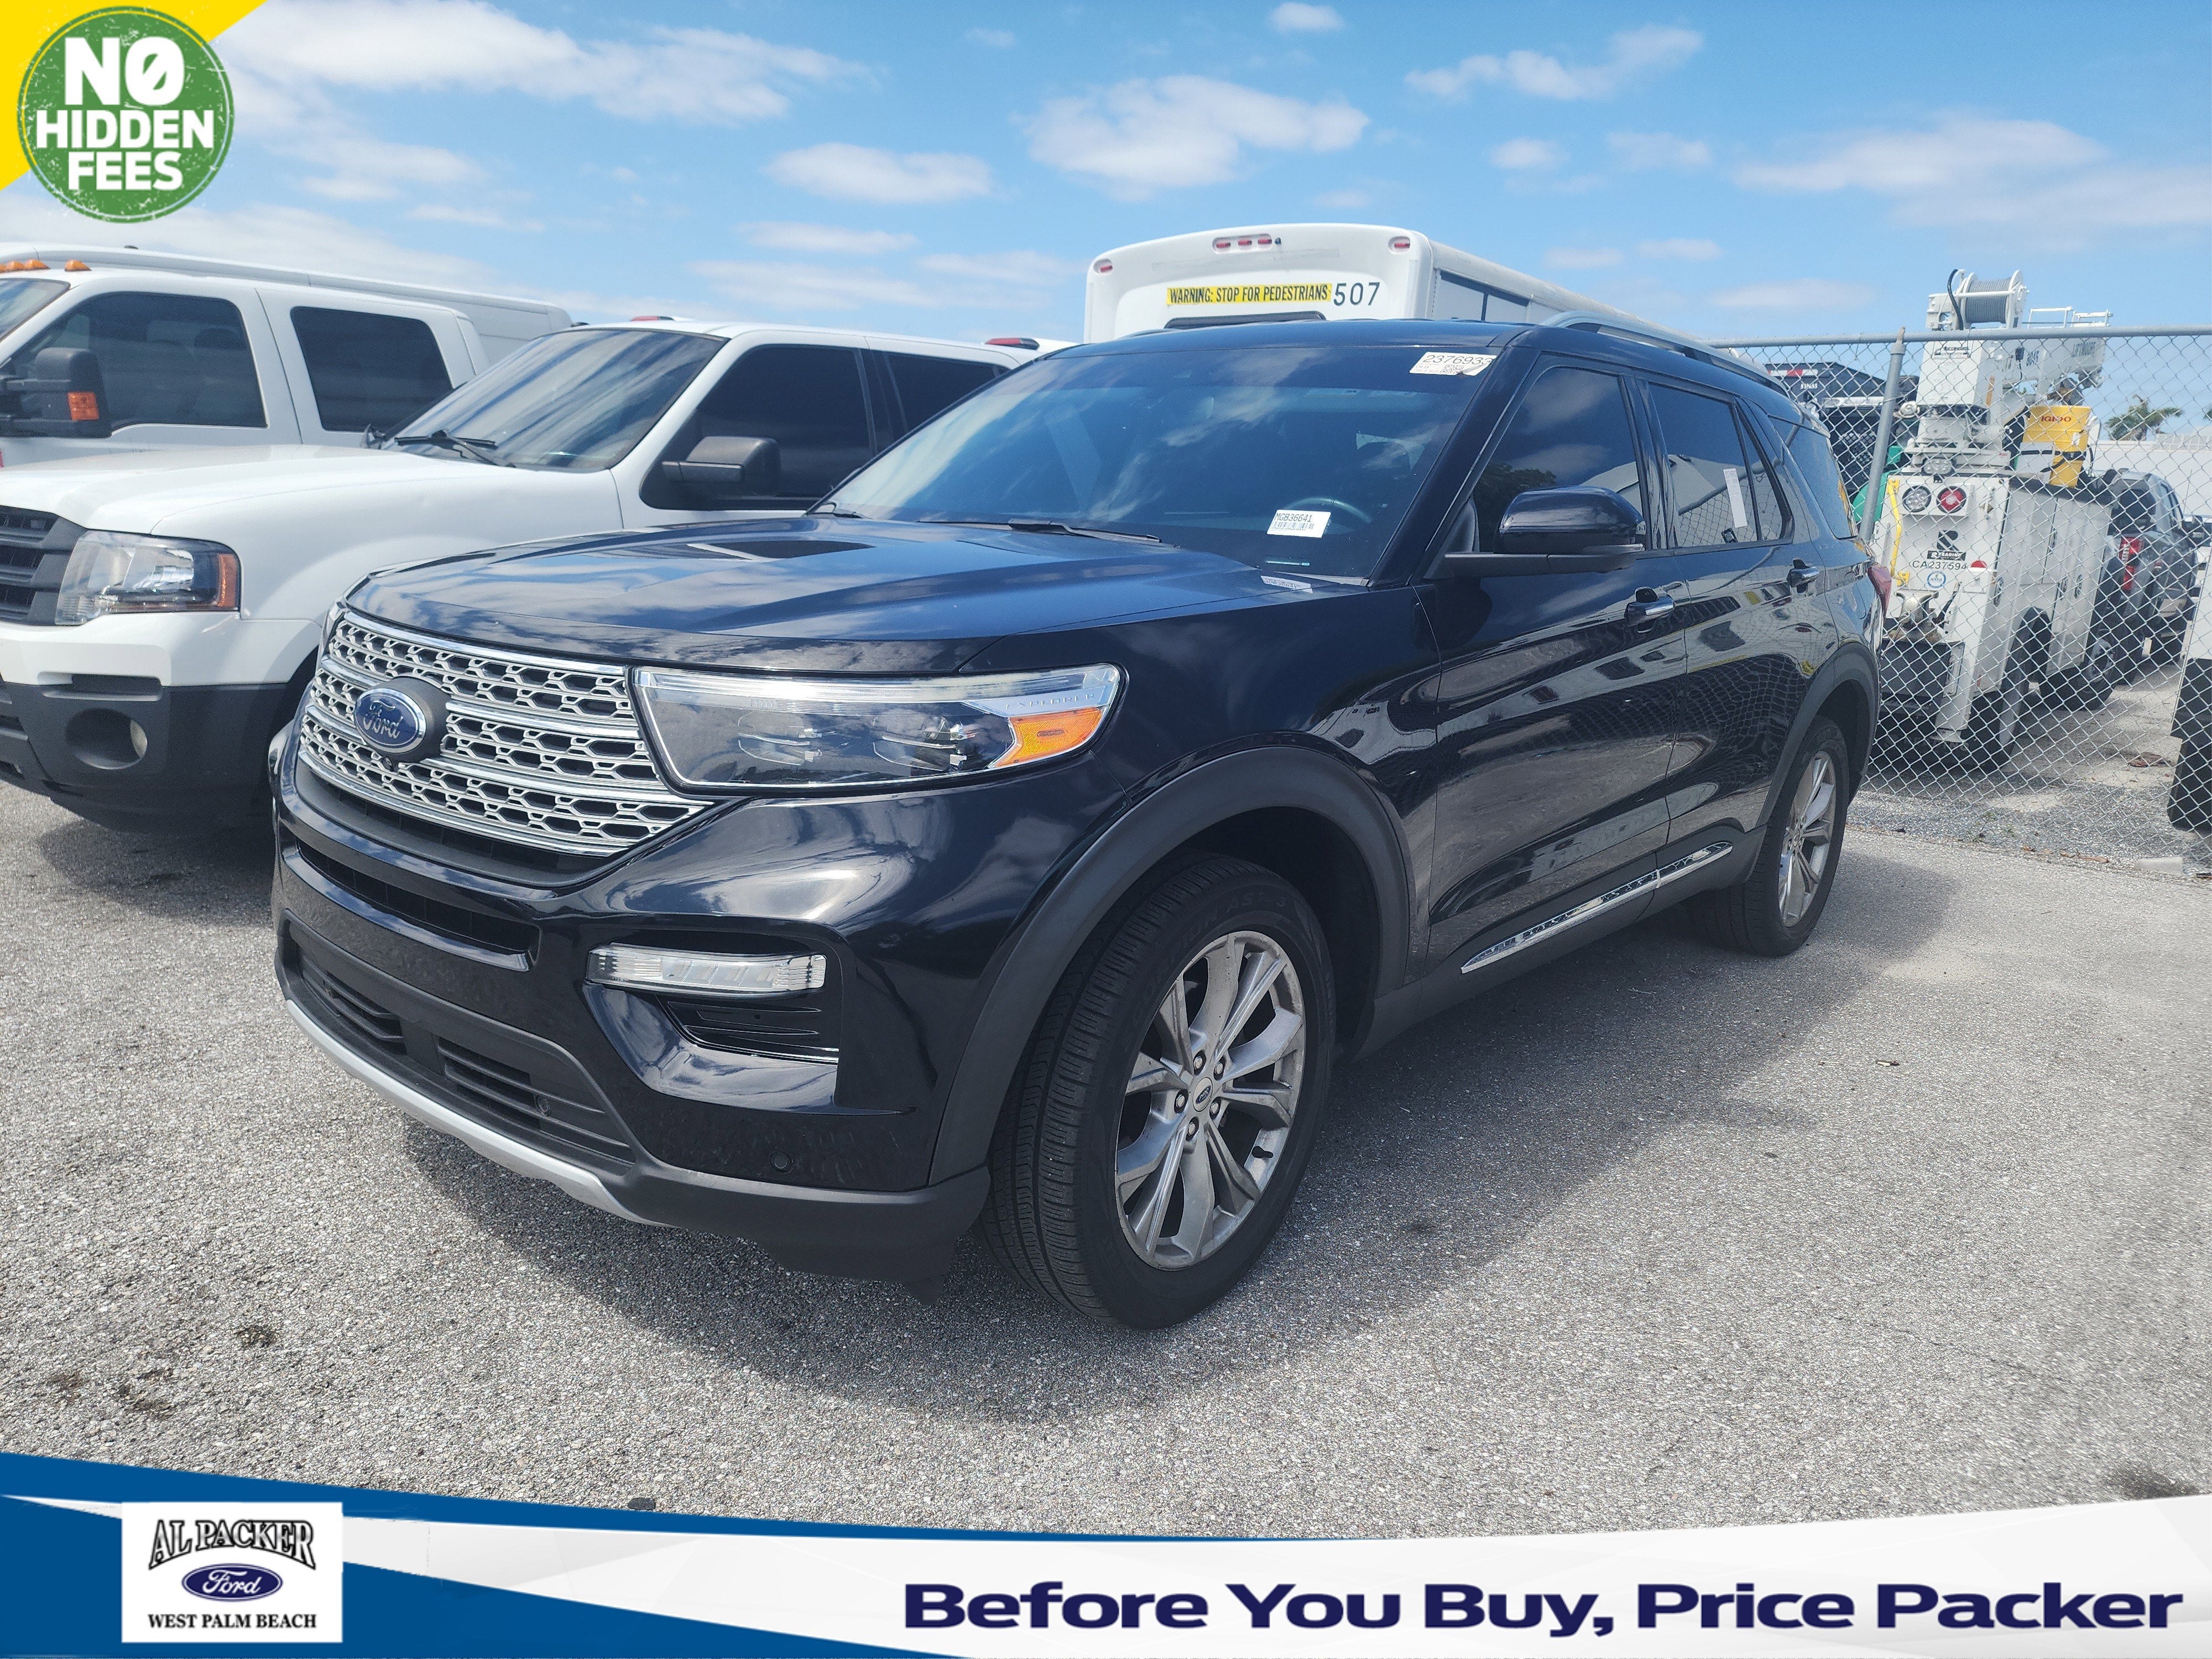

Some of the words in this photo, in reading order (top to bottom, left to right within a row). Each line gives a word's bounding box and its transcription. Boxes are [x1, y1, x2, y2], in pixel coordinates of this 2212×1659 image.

[1170, 286, 1213, 303] WARNING:
[1217, 286, 1239, 302] STOP
[1243, 286, 1260, 302] FOR
[1264, 284, 1328, 301] PEDESTRIANS
[1333, 281, 1380, 306] 507
